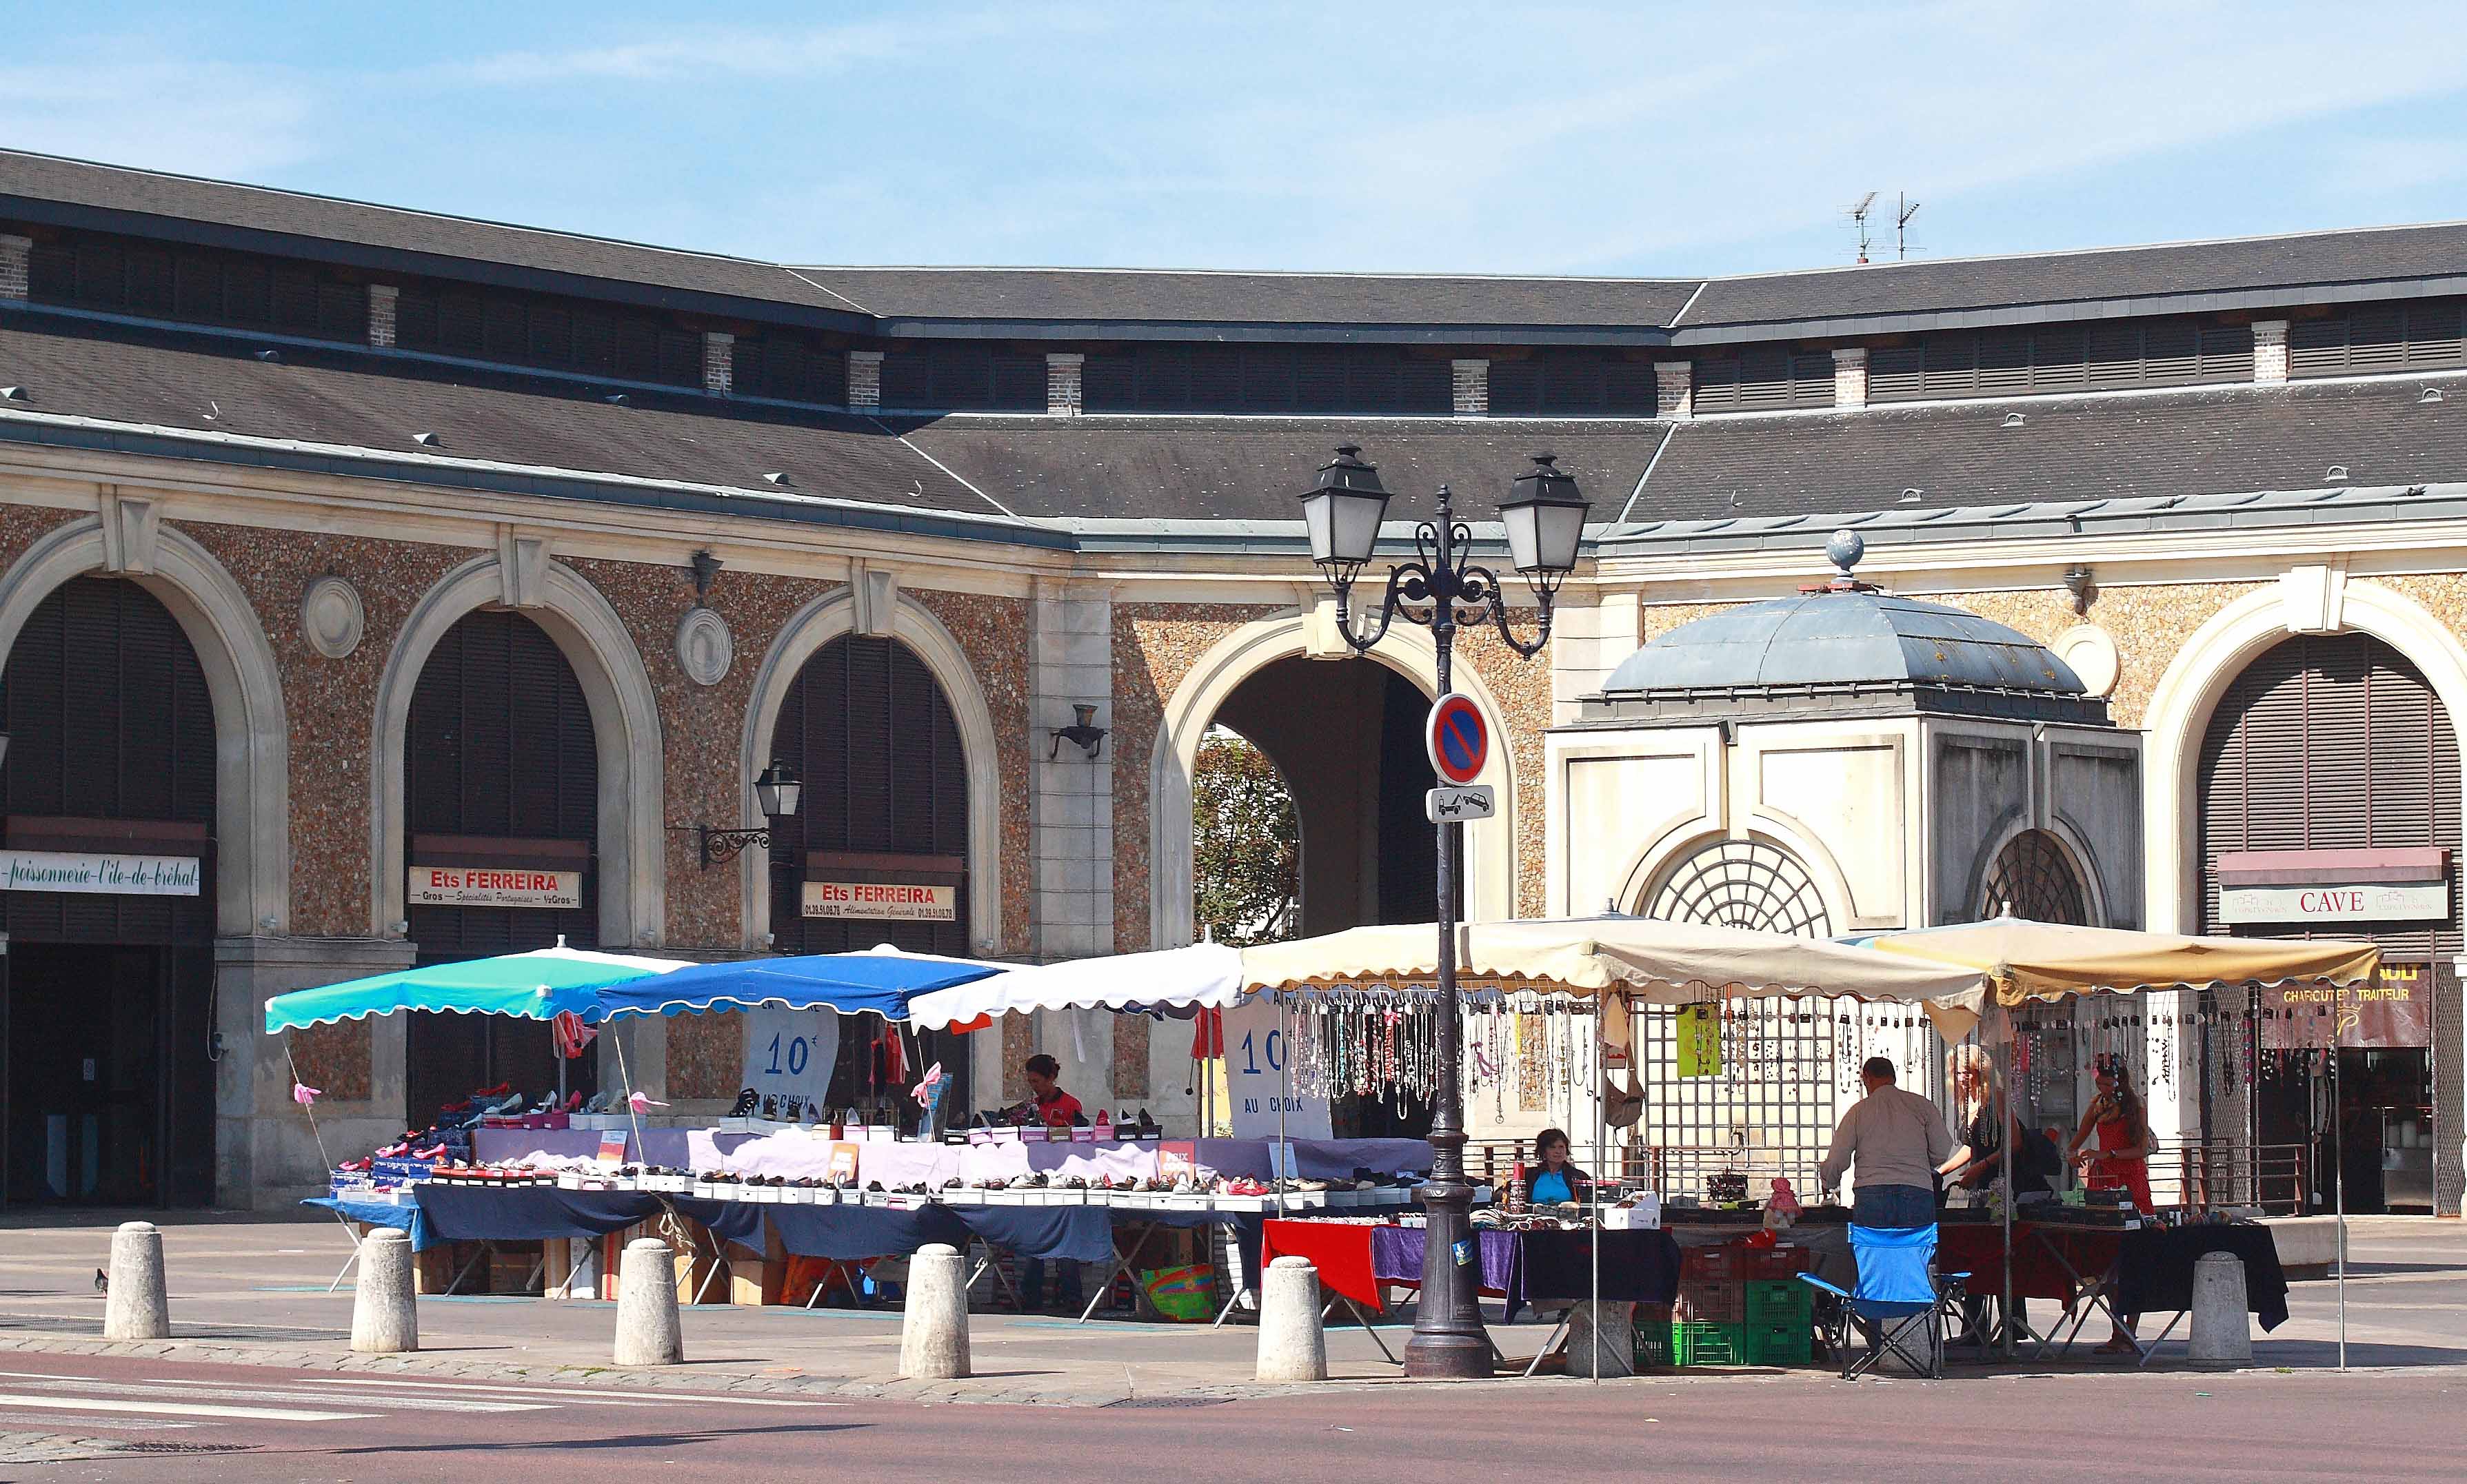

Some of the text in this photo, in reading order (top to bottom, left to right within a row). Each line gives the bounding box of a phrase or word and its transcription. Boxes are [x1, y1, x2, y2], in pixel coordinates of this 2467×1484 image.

[431, 871, 558, 891] Ets FERREIRA
[423, 891, 443, 900] Gros
[822, 885, 935, 904] Ets FERREIRA
[2300, 891, 2365, 913] CAVE
[2356, 988, 2409, 1002] TRAITEUR
[1245, 1098, 1258, 1113] AU
